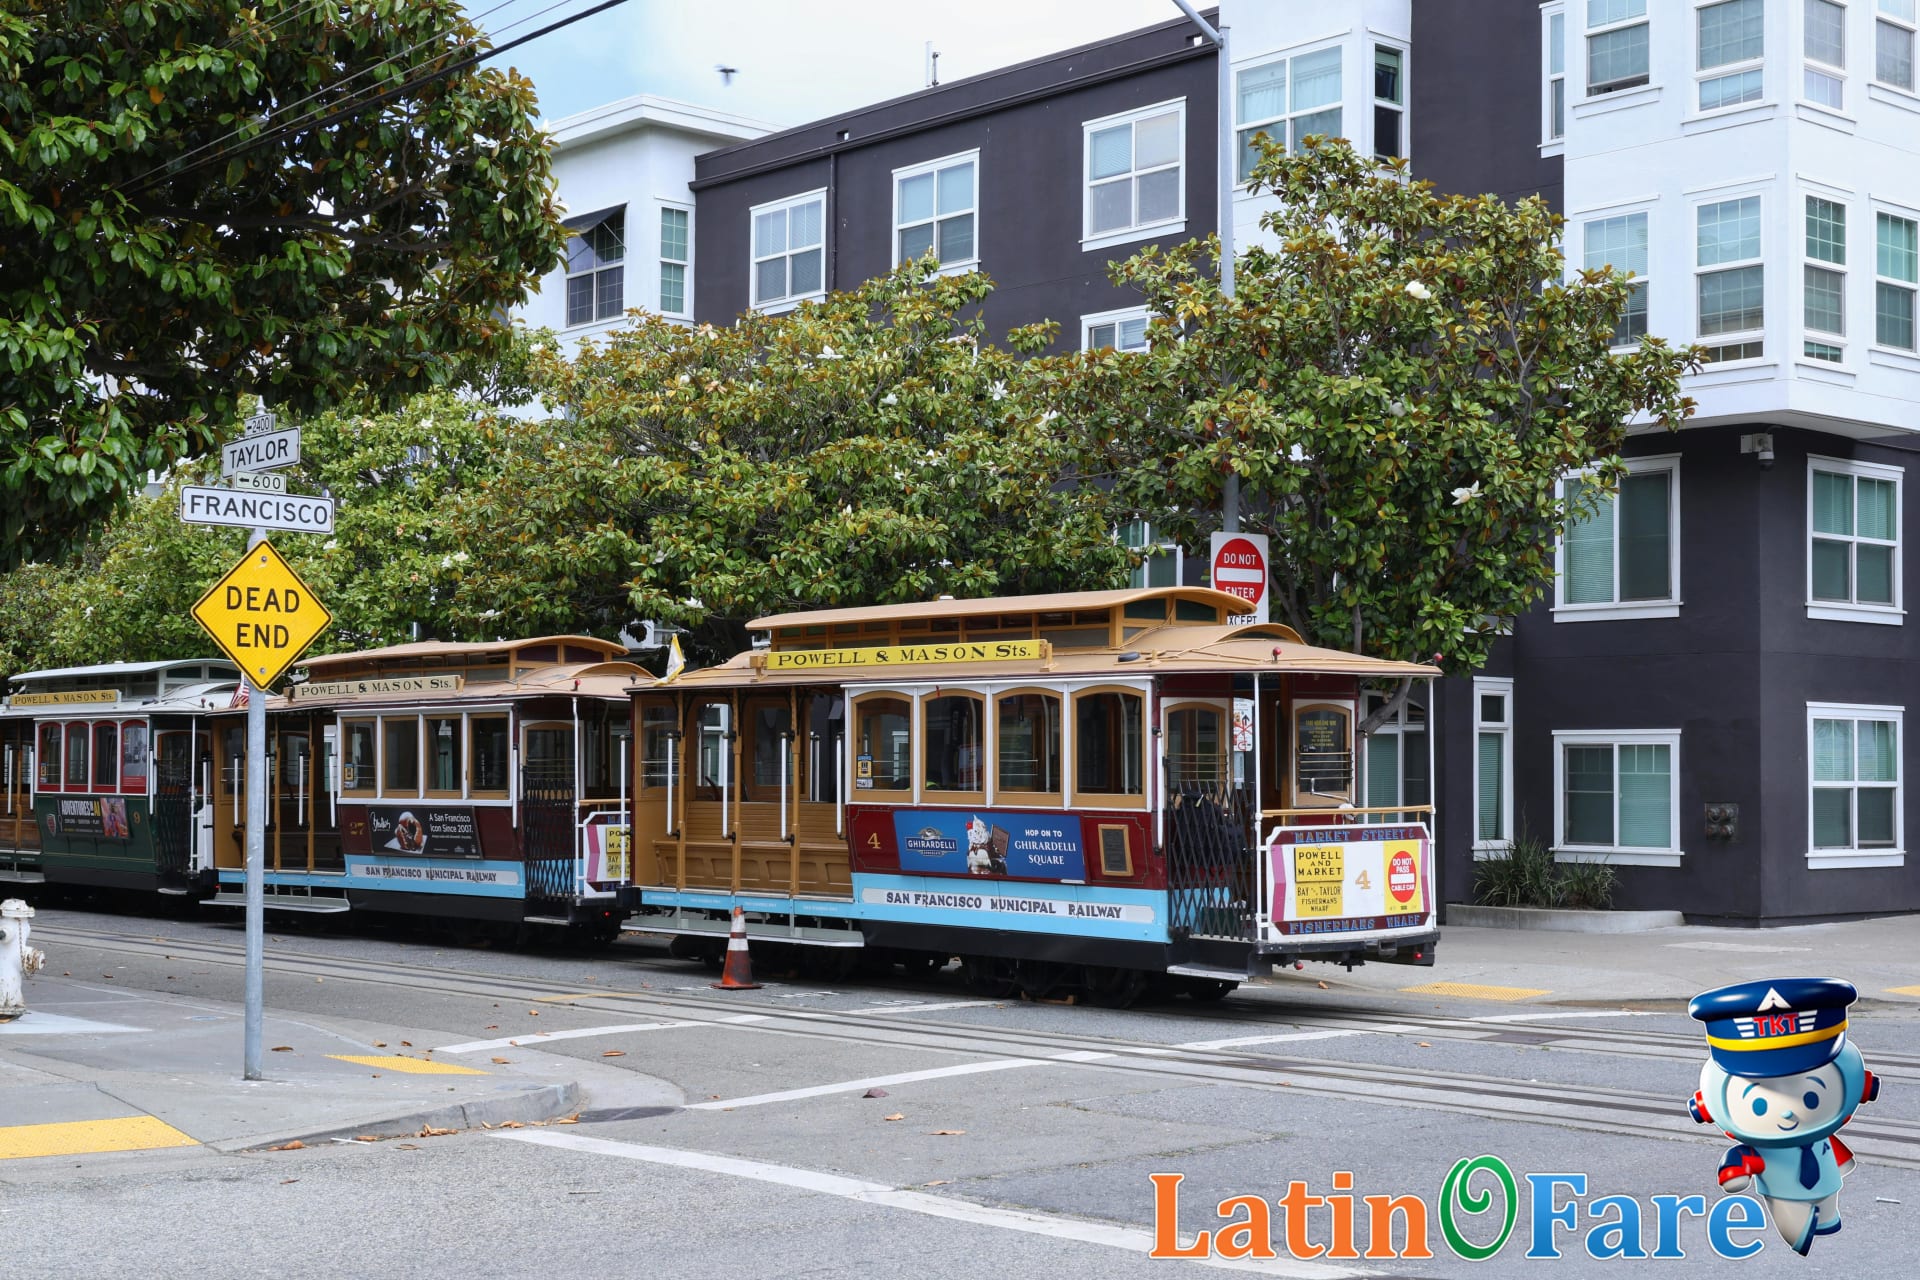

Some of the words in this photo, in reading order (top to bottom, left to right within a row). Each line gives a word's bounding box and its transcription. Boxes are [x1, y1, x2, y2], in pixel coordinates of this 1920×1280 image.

[252, 417, 270, 433] 2400
[230, 438, 288, 468] TAYLOR
[252, 476, 282, 490] 600
[190, 494, 328, 525] FRANCISCO
[1224, 553, 1236, 564] DO
[1238, 554, 1256, 566] NOT
[227, 586, 300, 613] DEAD
[1229, 616, 1258, 626] XCEPT
[236, 622, 290, 648] END
[778, 652, 866, 666] POWELL
[876, 650, 889, 662] &
[900, 646, 986, 662] MASON
[995, 644, 1032, 658] Sts.
[301, 684, 354, 696] POWELL
[358, 682, 368, 693] &
[372, 680, 422, 692] MASON
[430, 678, 452, 688] Sts.
[14, 695, 50, 704] POWELL
[64, 693, 96, 702] MASON
[429, 812, 434, 822] A
[434, 813, 444, 822] San
[444, 814, 471, 822] Francisco
[350, 822, 366, 836] 27
[430, 824, 442, 832] Icon
[442, 824, 457, 832] Since
[1025, 829, 1039, 837] HOP
[1041, 830, 1050, 838] ON
[1052, 830, 1062, 838] TO
[868, 832, 881, 849] 4
[1294, 830, 1350, 844] MARKET
[1361, 828, 1406, 841] STREET
[908, 840, 956, 850] GHIRARDELLI
[1014, 840, 1076, 852] GHIRARDELLI
[1028, 854, 1065, 865] SQUARE
[1298, 852, 1342, 860] POWELL
[1392, 858, 1402, 866] DO
[1402, 858, 1412, 866] NOT
[366, 866, 380, 876] SAN
[382, 868, 422, 878] FRANCISCO
[426, 869, 464, 880] MUNICIPAL
[466, 871, 497, 882] RAILWAY
[1298, 867, 1342, 876] MARKET
[1355, 870, 1372, 890] 4
[1297, 886, 1309, 897] BAY
[1320, 886, 1341, 896] TAYLOR
[886, 892, 910, 904] SAN
[914, 894, 982, 908] FRANCISCO
[990, 898, 1056, 914] MUNICIPAL
[1068, 904, 1122, 918] RAILWAY
[1289, 919, 1376, 934] FISHERMANS
[1386, 914, 1420, 927] WHARF
